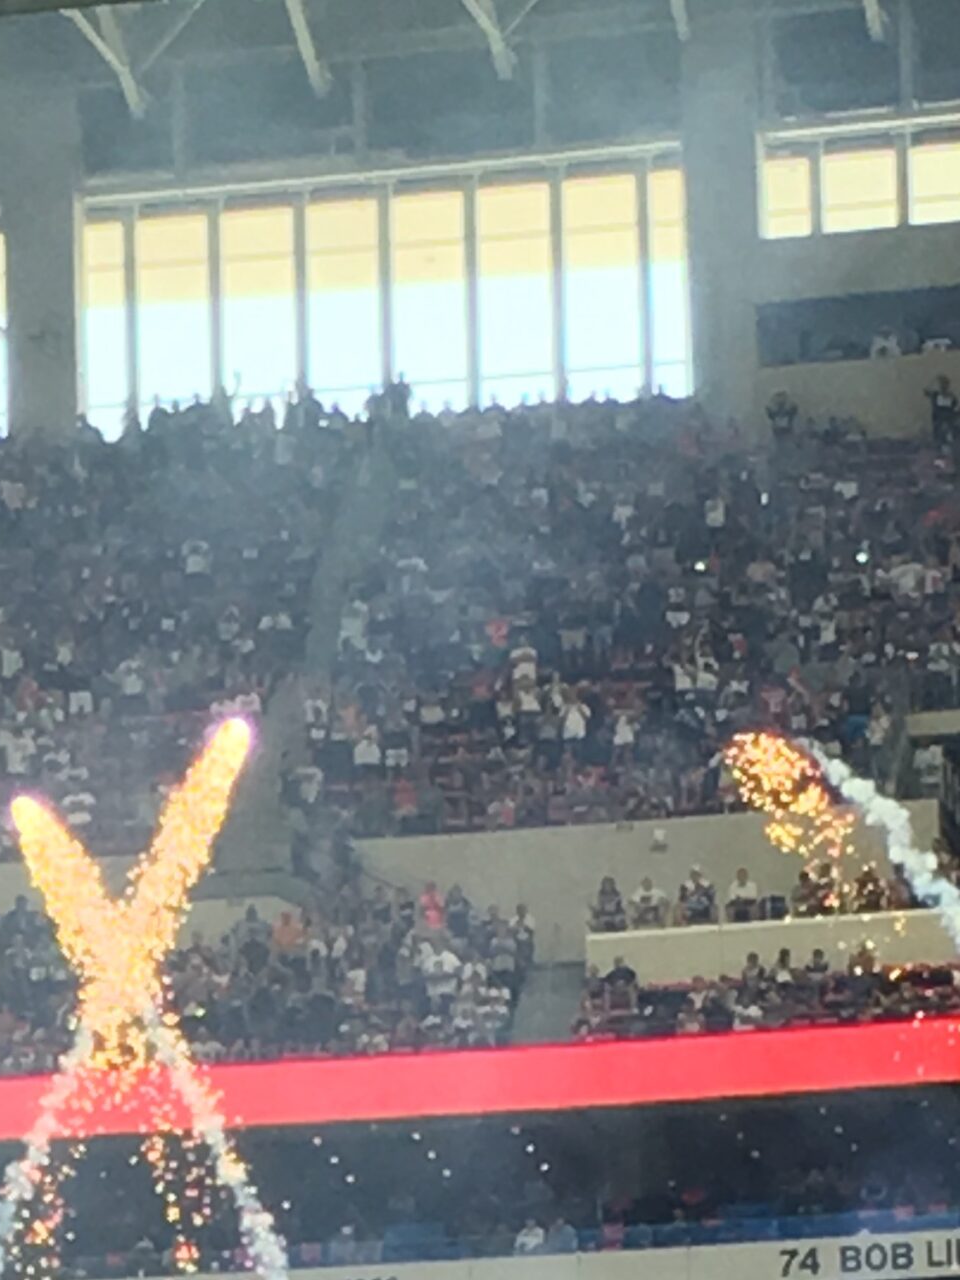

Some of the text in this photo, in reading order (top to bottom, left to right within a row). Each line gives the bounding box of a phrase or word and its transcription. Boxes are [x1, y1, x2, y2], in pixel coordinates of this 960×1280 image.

[780, 1238, 960, 1278] 74 BOB LI
